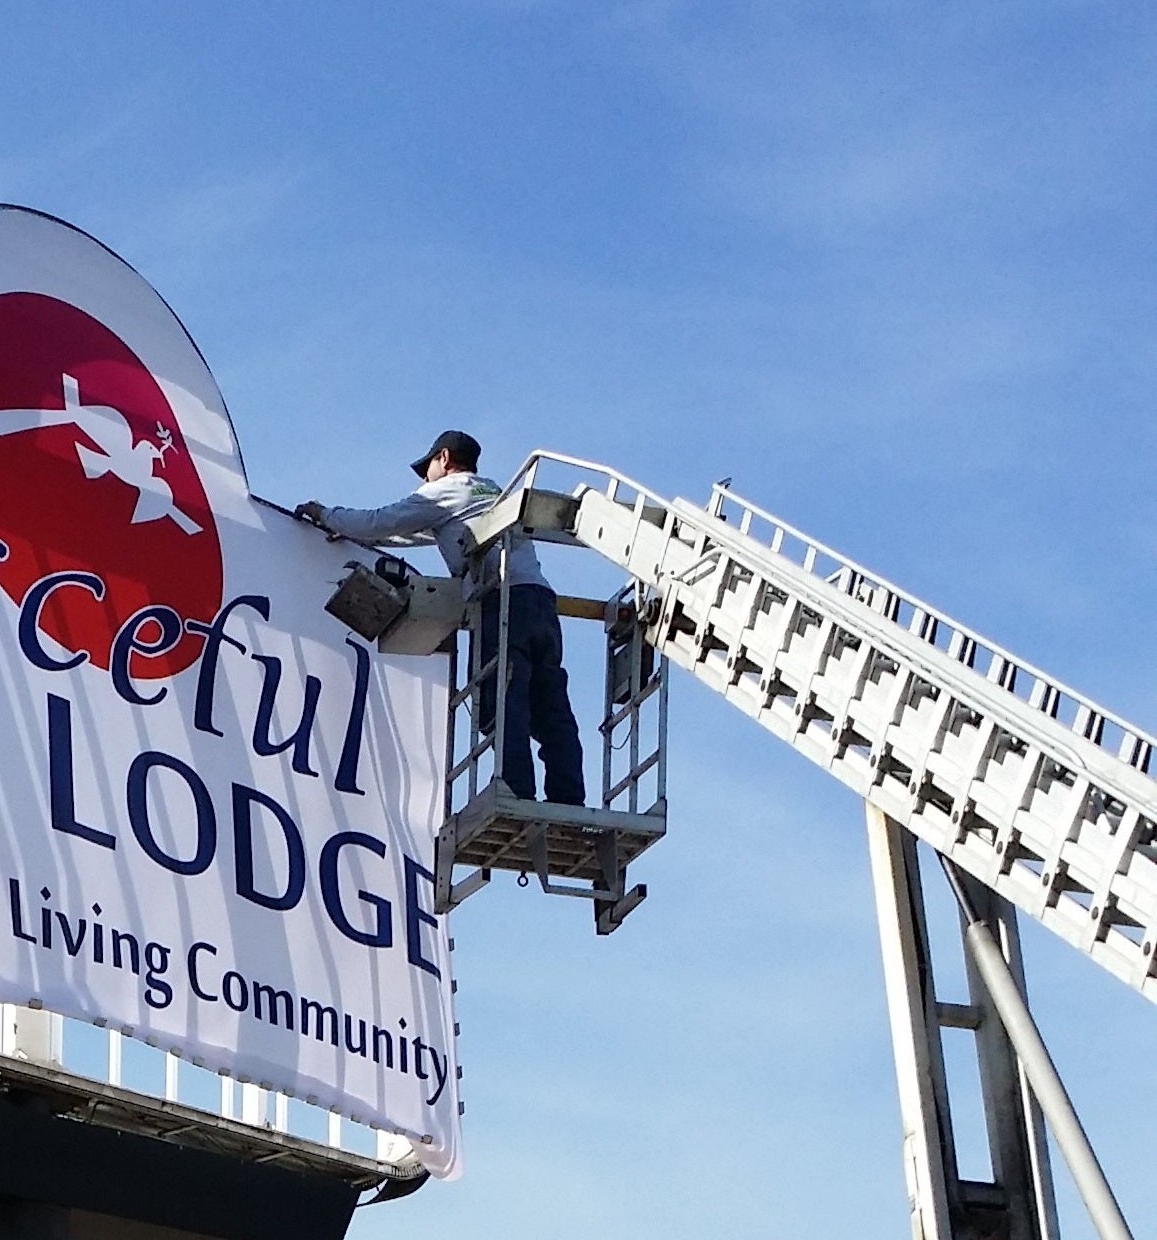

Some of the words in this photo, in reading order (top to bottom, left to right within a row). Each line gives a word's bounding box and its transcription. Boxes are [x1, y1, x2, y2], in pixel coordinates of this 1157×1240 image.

[47, 692, 441, 977] LODGE
[10, 878, 174, 1009] Living
[187, 941, 448, 1106] Community
